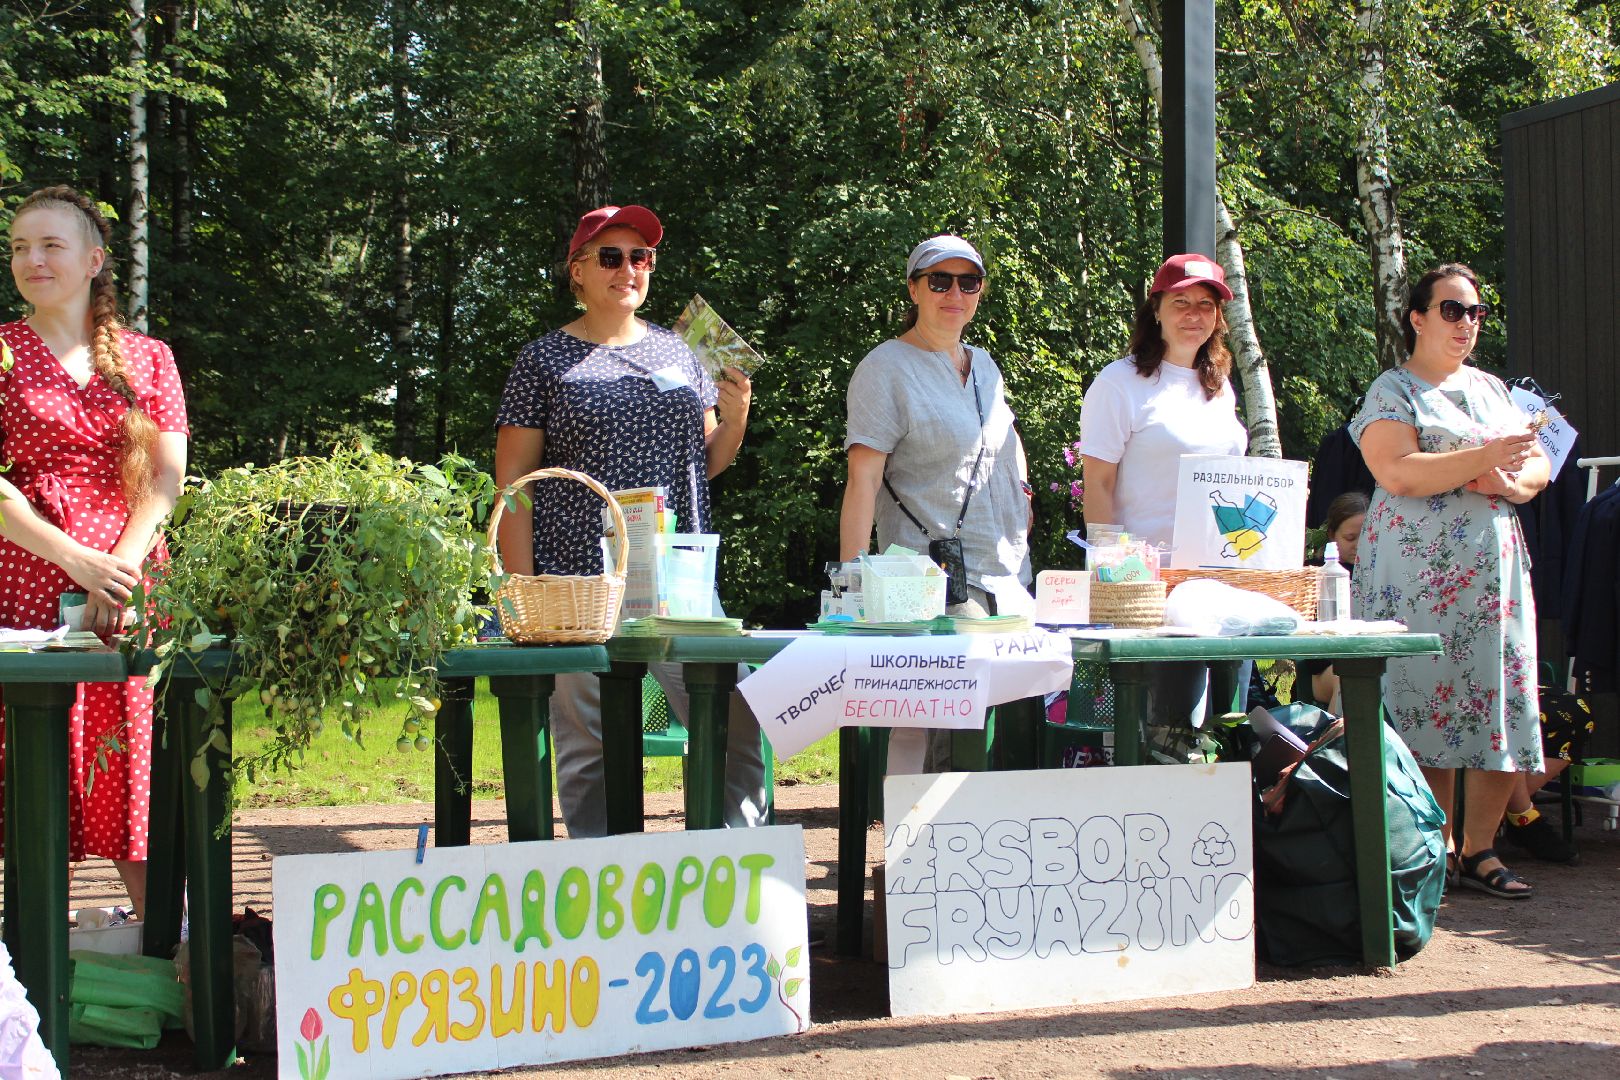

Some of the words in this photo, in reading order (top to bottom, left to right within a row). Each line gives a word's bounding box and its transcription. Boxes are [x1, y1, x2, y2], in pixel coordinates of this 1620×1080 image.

[1193, 472, 1264, 486] РАЗДЕЛЬНЫЙ
[1266, 476, 1294, 488] СБОР
[870, 654, 966, 669] ШКОЛЬНЫЕ
[854, 678, 977, 691] ПРИНАДЛЕЖНОСТИ
[845, 698, 972, 718] БЕСПЛАТНО
[310, 853, 775, 960] РАССАДОВОРОТ
